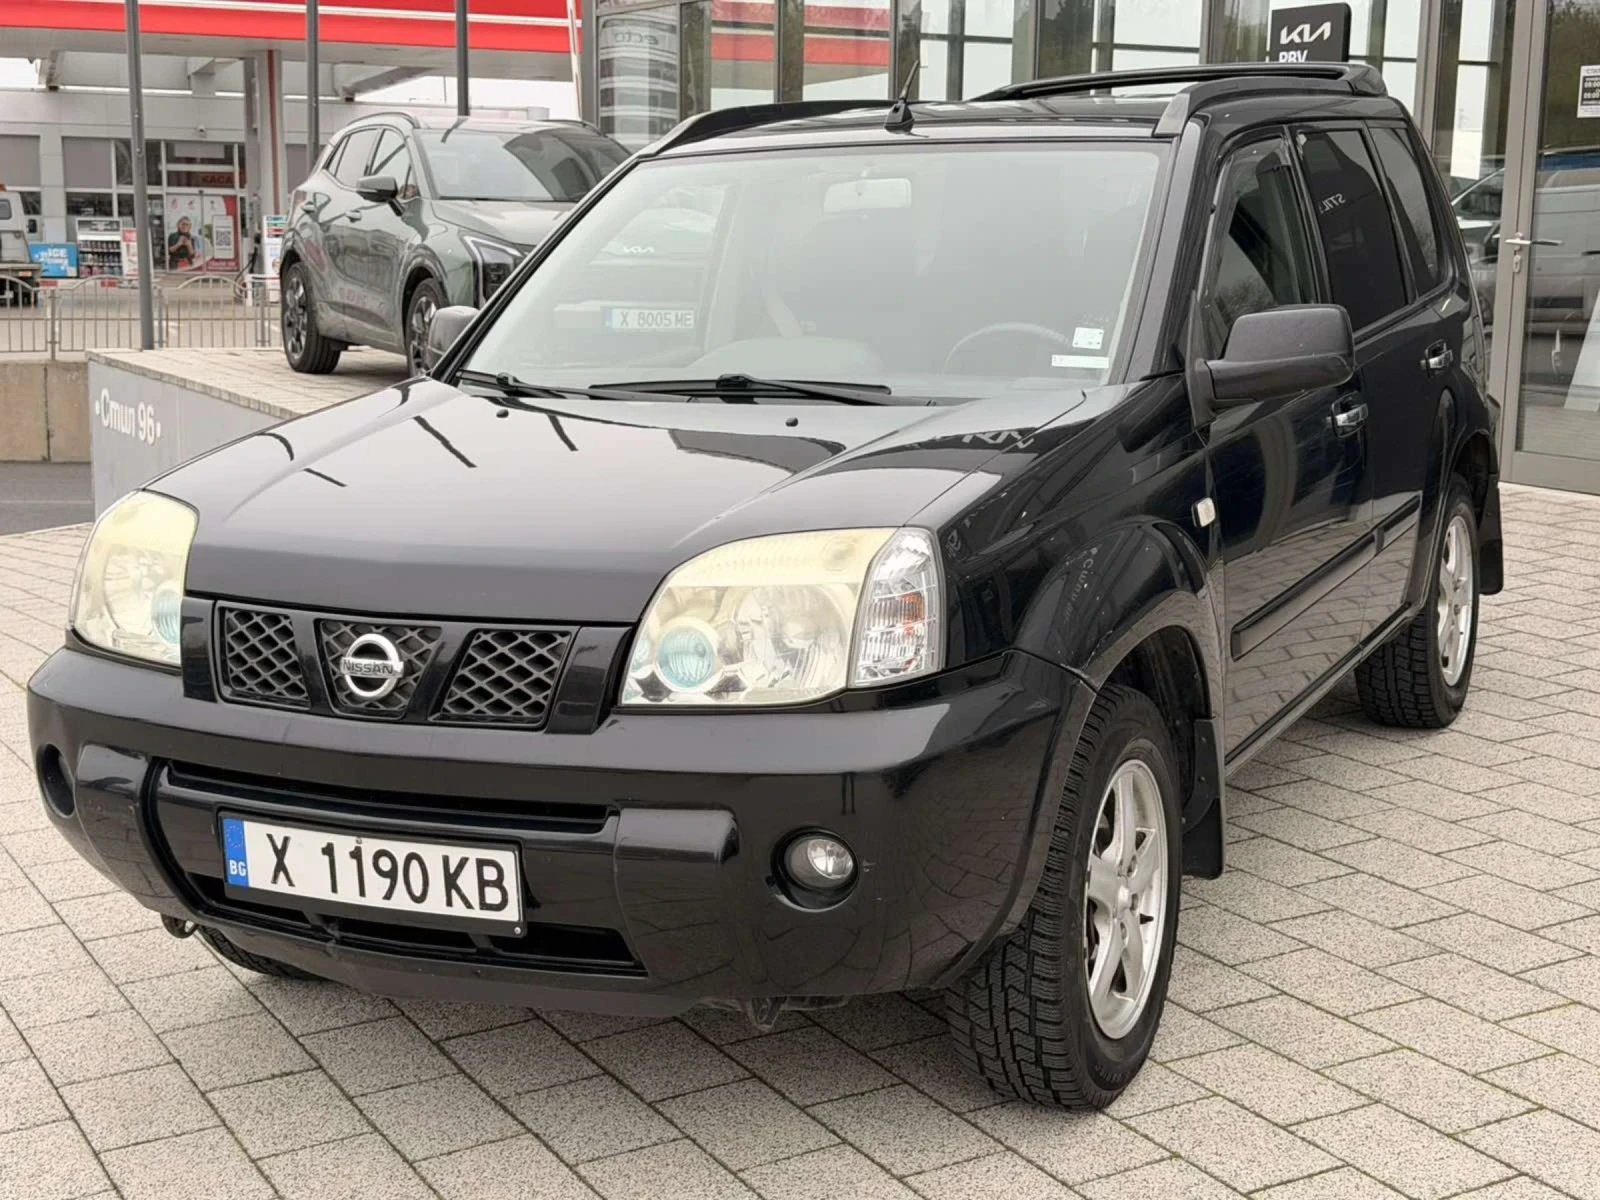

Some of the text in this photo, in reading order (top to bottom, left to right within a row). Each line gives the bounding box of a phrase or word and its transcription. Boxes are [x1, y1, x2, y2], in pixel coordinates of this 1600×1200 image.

[1280, 21, 1331, 44] KIA
[620, 311, 629, 327] X
[637, 311, 672, 327] 8005
[138, 401, 155, 445] 96
[343, 660, 394, 674] NISSAN
[229, 833, 509, 912] BG X 1190 KB
